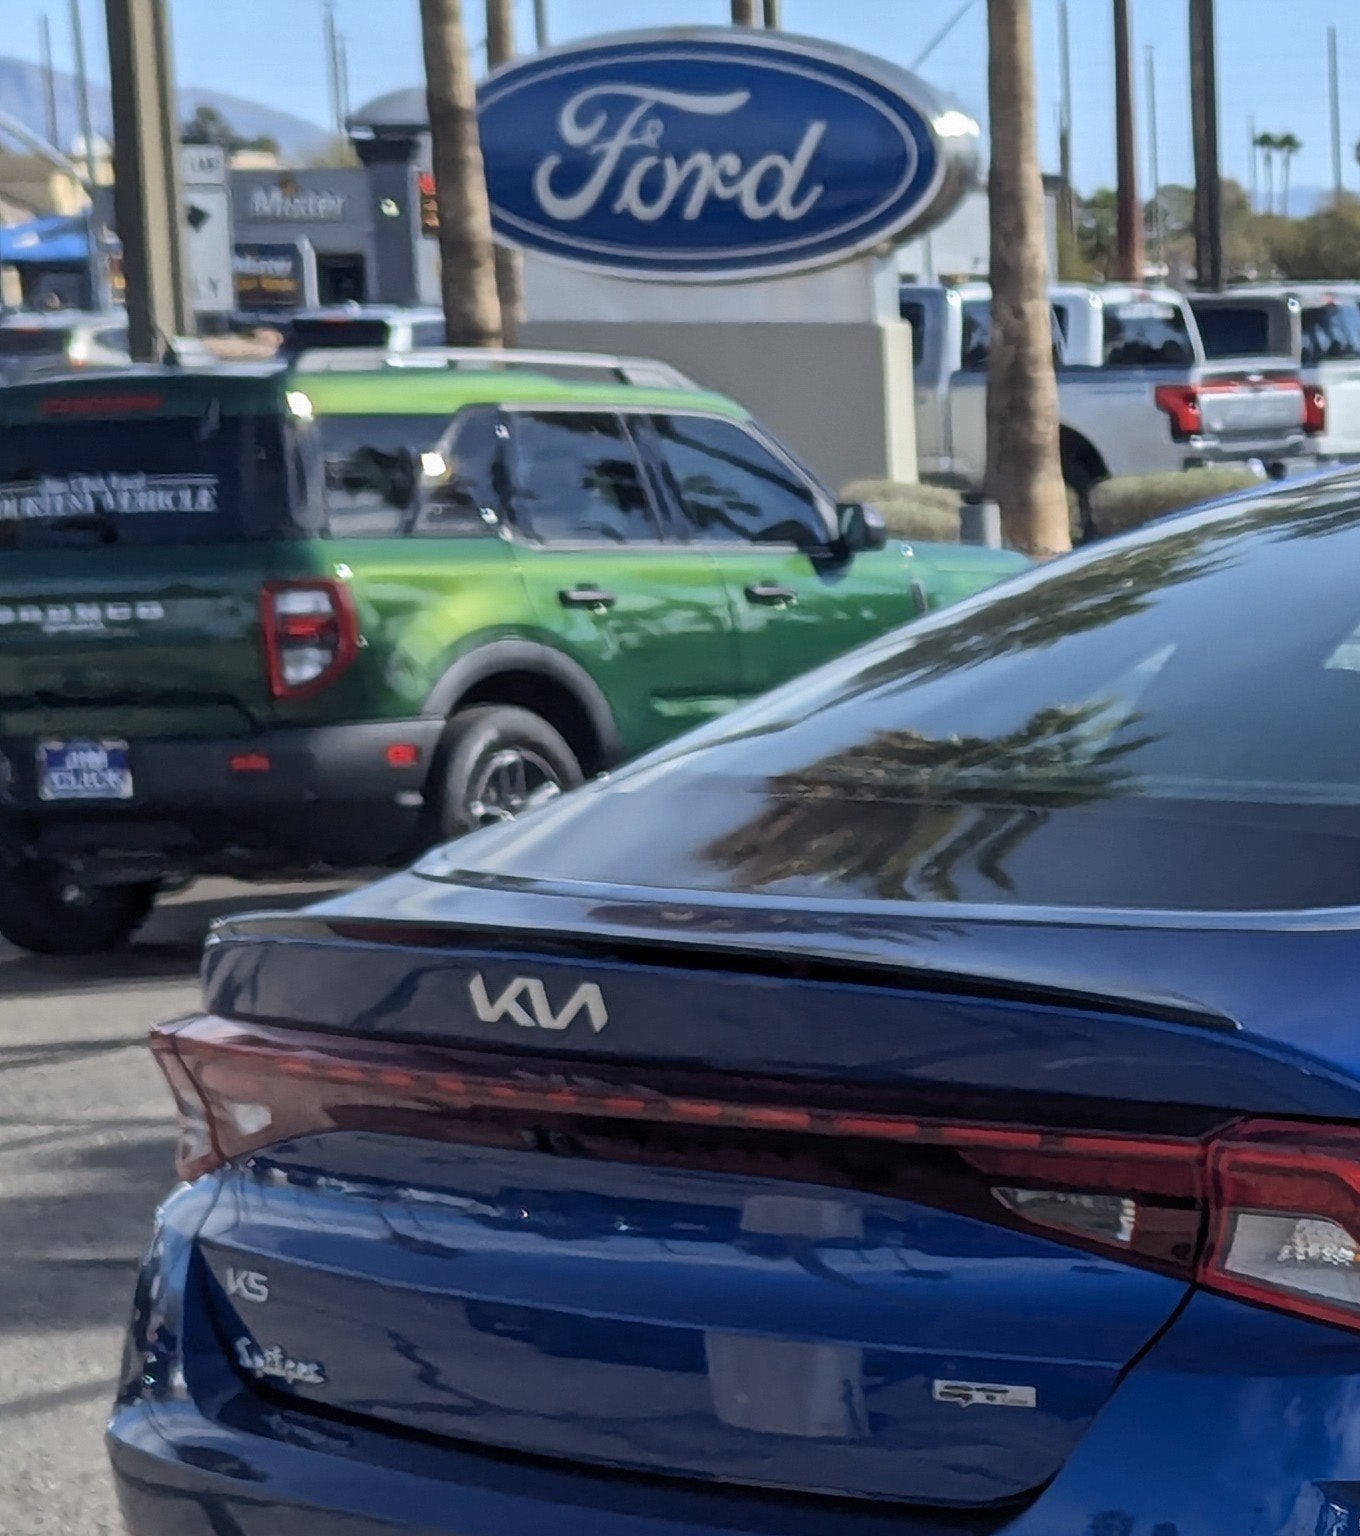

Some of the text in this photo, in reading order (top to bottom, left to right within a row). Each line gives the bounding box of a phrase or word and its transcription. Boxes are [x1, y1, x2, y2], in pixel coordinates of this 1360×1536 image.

[533, 82, 827, 221] Ford
[469, 971, 609, 1034] KIA
[226, 1267, 269, 1302] K5
